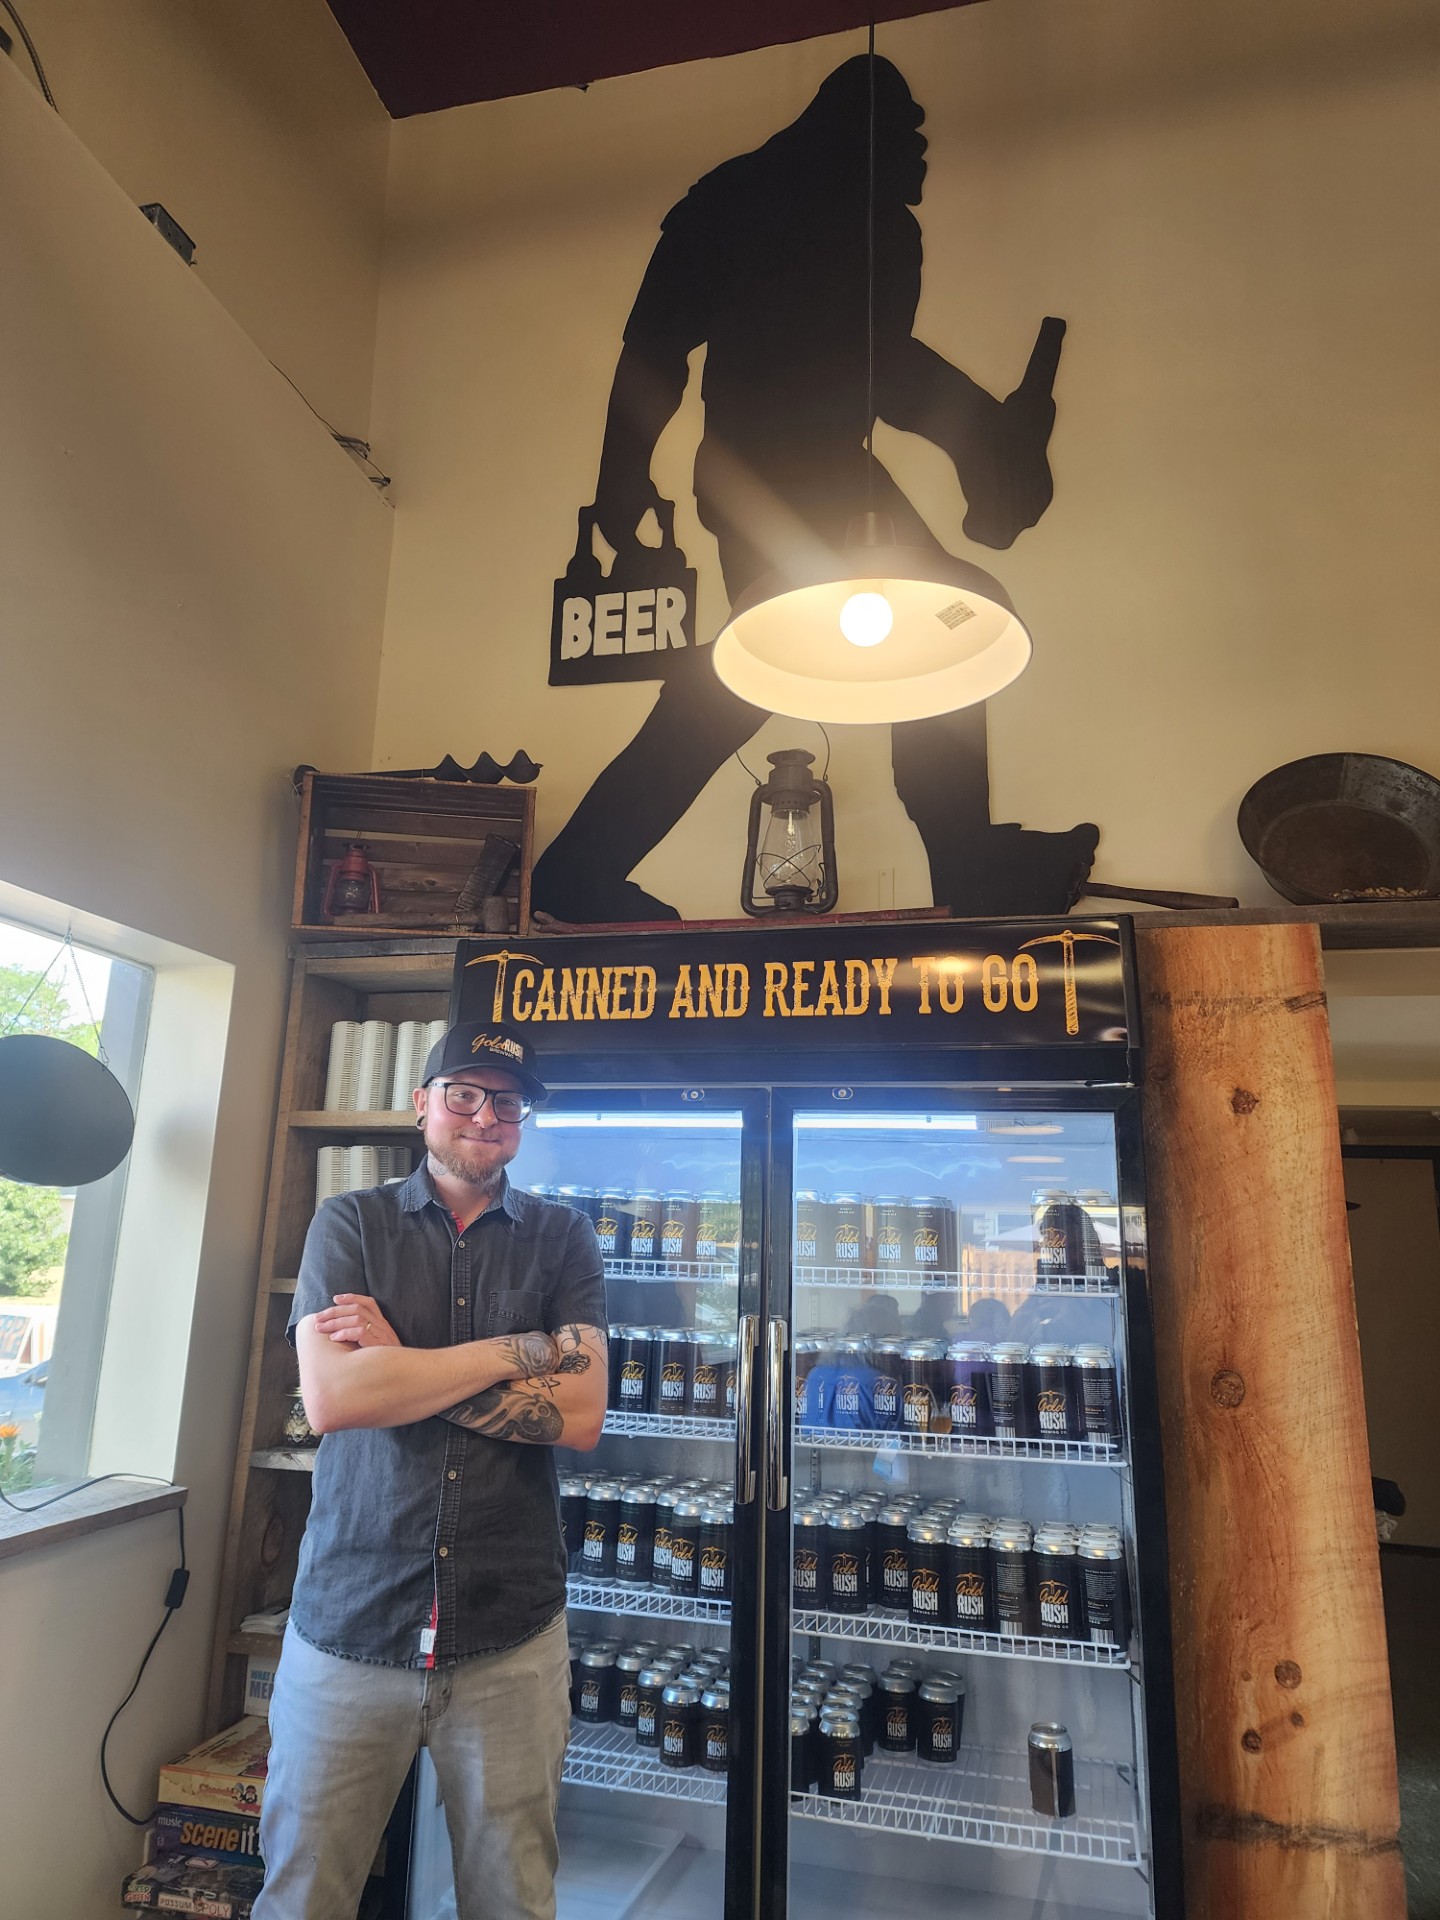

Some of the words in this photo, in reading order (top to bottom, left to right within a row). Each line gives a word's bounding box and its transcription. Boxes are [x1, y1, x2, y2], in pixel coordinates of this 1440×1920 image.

[561, 586, 687, 660] BEER
[512, 965, 657, 1021] CANNED
[668, 963, 750, 1018] AND
[763, 958, 898, 1017] READY
[912, 956, 965, 1014] TO
[981, 953, 1039, 1012] GO
[471, 1033, 507, 1053] Gold
[631, 1238, 653, 1253] RUSH
[661, 1238, 682, 1253] RUSH
[696, 1241, 716, 1256] RUSH
[835, 1242, 859, 1258] RUSH
[878, 1244, 901, 1259] RUSH
[915, 1246, 938, 1261] RUSH
[1041, 1247, 1067, 1264] RUSH
[621, 1379, 643, 1395] RUSH
[662, 1380, 684, 1397] RUSH
[694, 1383, 717, 1400] RUSH
[836, 1394, 859, 1411] RUSH
[874, 1393, 896, 1411] RUSH
[904, 1403, 928, 1423] RUSH
[952, 1405, 976, 1423] RUSH
[1040, 1410, 1066, 1430] RUSH
[583, 1539, 603, 1558] RUSH
[617, 1542, 635, 1561] RUSH
[653, 1545, 672, 1566] RUSH
[672, 1557, 693, 1577] RUSH
[701, 1566, 725, 1588] RUSH
[833, 1573, 857, 1592] RUSH
[884, 1568, 908, 1588] RUSH
[912, 1590, 938, 1611] RUSH
[957, 1594, 984, 1616] RUSH
[1040, 1602, 1068, 1624] RUSH
[580, 1693, 599, 1710] RUSH
[638, 1714, 655, 1733] RUSH
[887, 1721, 907, 1738] RUSH
[664, 1735, 683, 1753] RUSH
[707, 1740, 727, 1757] RUSH
[932, 1732, 952, 1748] RUSH
[834, 1770, 855, 1788] RUSH
[158, 1816, 182, 1828] music
[180, 1821, 240, 1852] scene
[124, 1892, 151, 1903] GREEN
